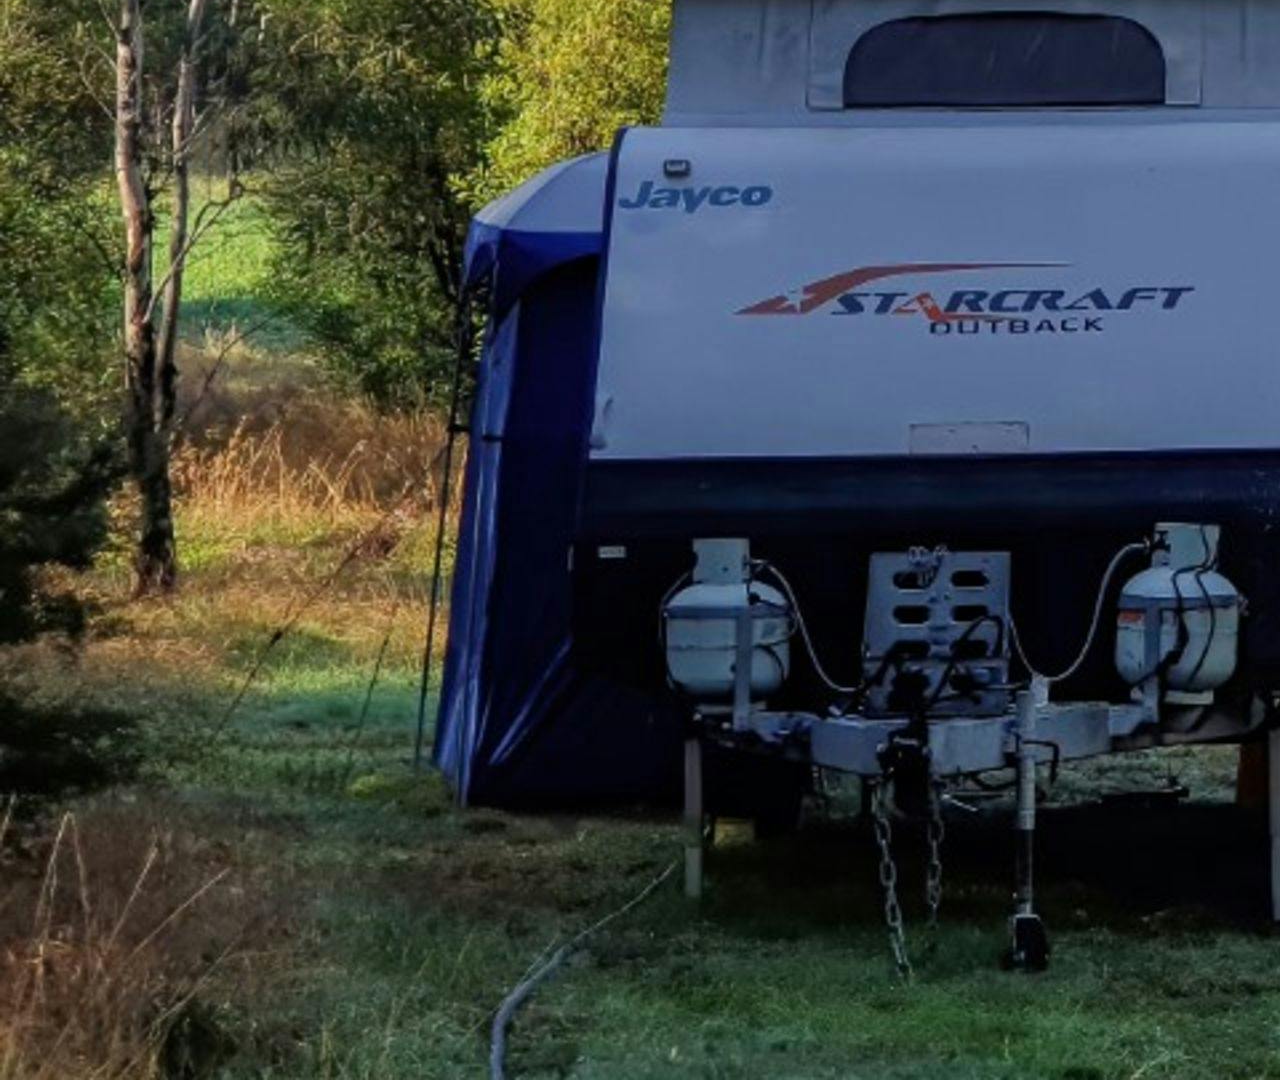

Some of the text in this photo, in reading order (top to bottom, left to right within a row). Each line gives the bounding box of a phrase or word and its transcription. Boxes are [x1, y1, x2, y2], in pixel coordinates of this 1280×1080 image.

[618, 181, 773, 214] Jayco
[830, 286, 1195, 316] STARCRAFT
[929, 317, 1104, 335] OUTBACK
